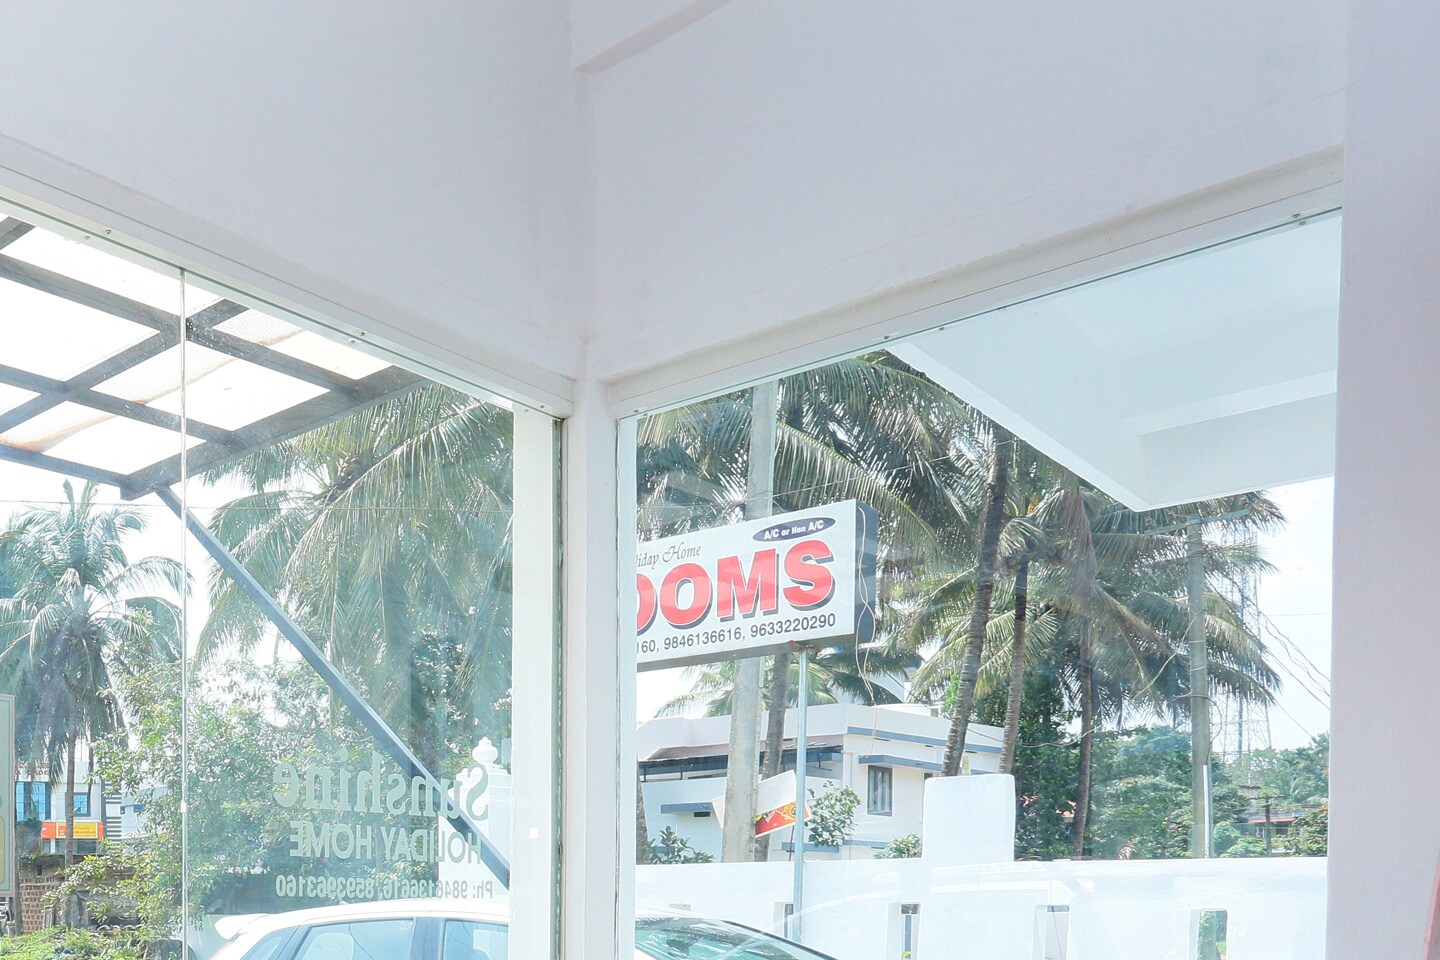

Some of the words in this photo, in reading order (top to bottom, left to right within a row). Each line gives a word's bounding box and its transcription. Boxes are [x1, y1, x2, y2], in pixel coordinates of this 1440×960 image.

[763, 528, 780, 540] A/C
[781, 529, 790, 537] or
[791, 526, 806, 535] Non
[808, 520, 825, 532] A/C
[662, 542, 702, 563] Home
[663, 627, 746, 650] 9846136616,
[750, 613, 836, 638] 9633220290
